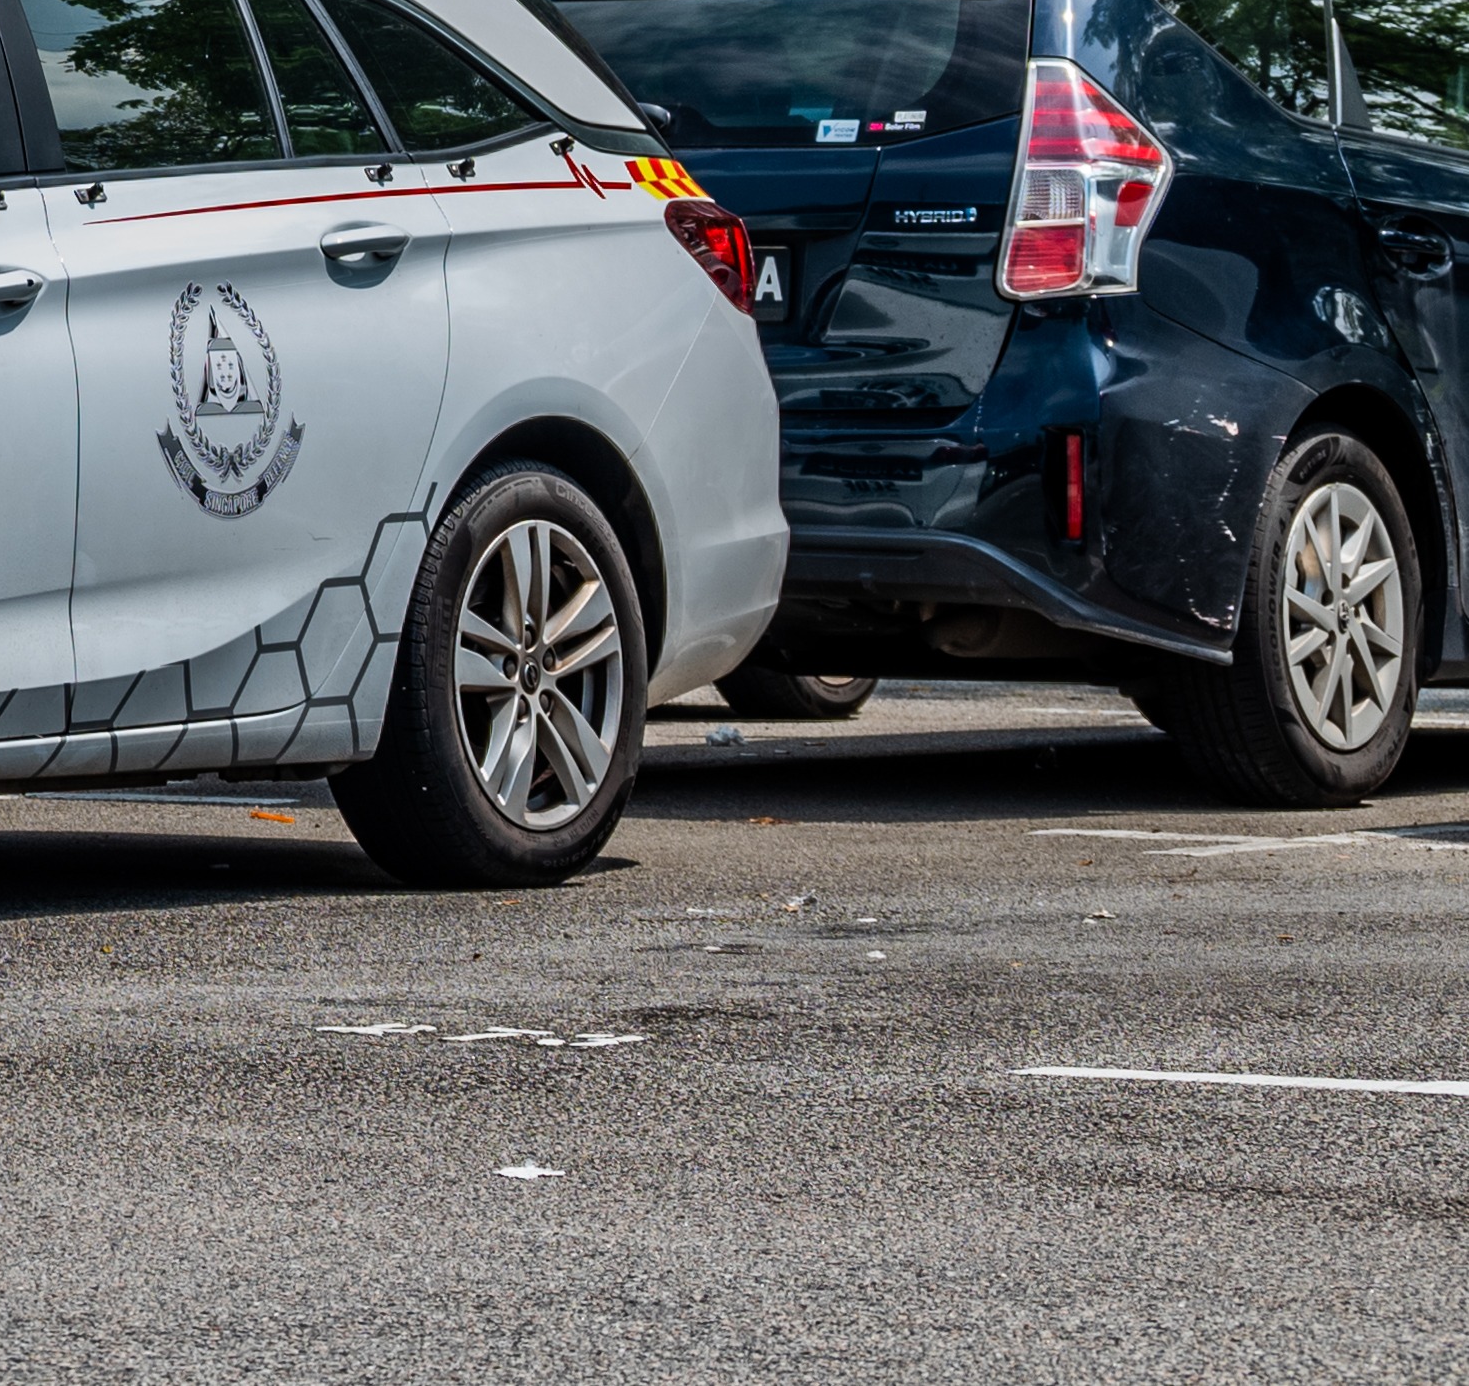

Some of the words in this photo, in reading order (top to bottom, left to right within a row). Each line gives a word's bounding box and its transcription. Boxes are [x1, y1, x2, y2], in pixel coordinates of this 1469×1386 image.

[885, 123, 904, 131] Solar
[895, 210, 964, 223] HYBRID
[204, 488, 259, 515] SINGAPORE
